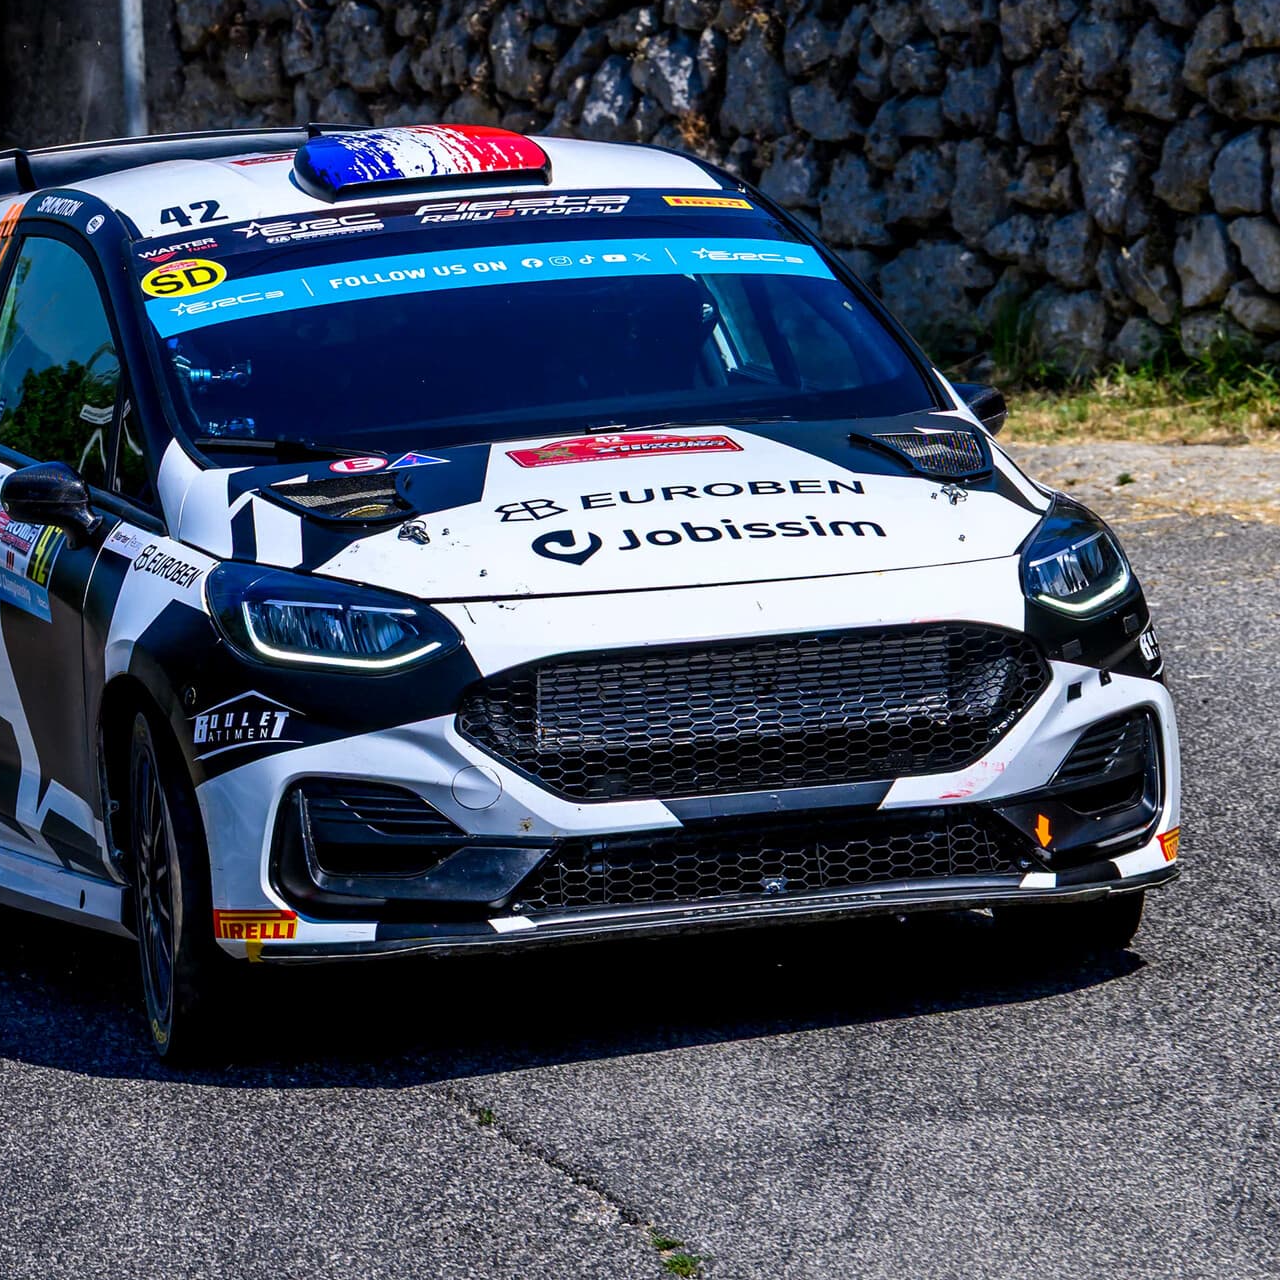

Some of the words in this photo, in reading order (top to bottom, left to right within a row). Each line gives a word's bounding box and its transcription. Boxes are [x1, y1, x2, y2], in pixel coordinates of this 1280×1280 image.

[160, 200, 228, 227] 42
[415, 195, 631, 216] Fiesta
[137, 237, 216, 259] WARTER
[150, 266, 218, 295] SD
[329, 267, 426, 290] FOLLOW
[432, 263, 468, 278] US
[473, 260, 508, 274] ON
[580, 479, 865, 510] EUROBEN
[618, 515, 887, 551] Jobissim
[145, 552, 204, 589] EUROBEN
[193, 711, 290, 744] BOULET
